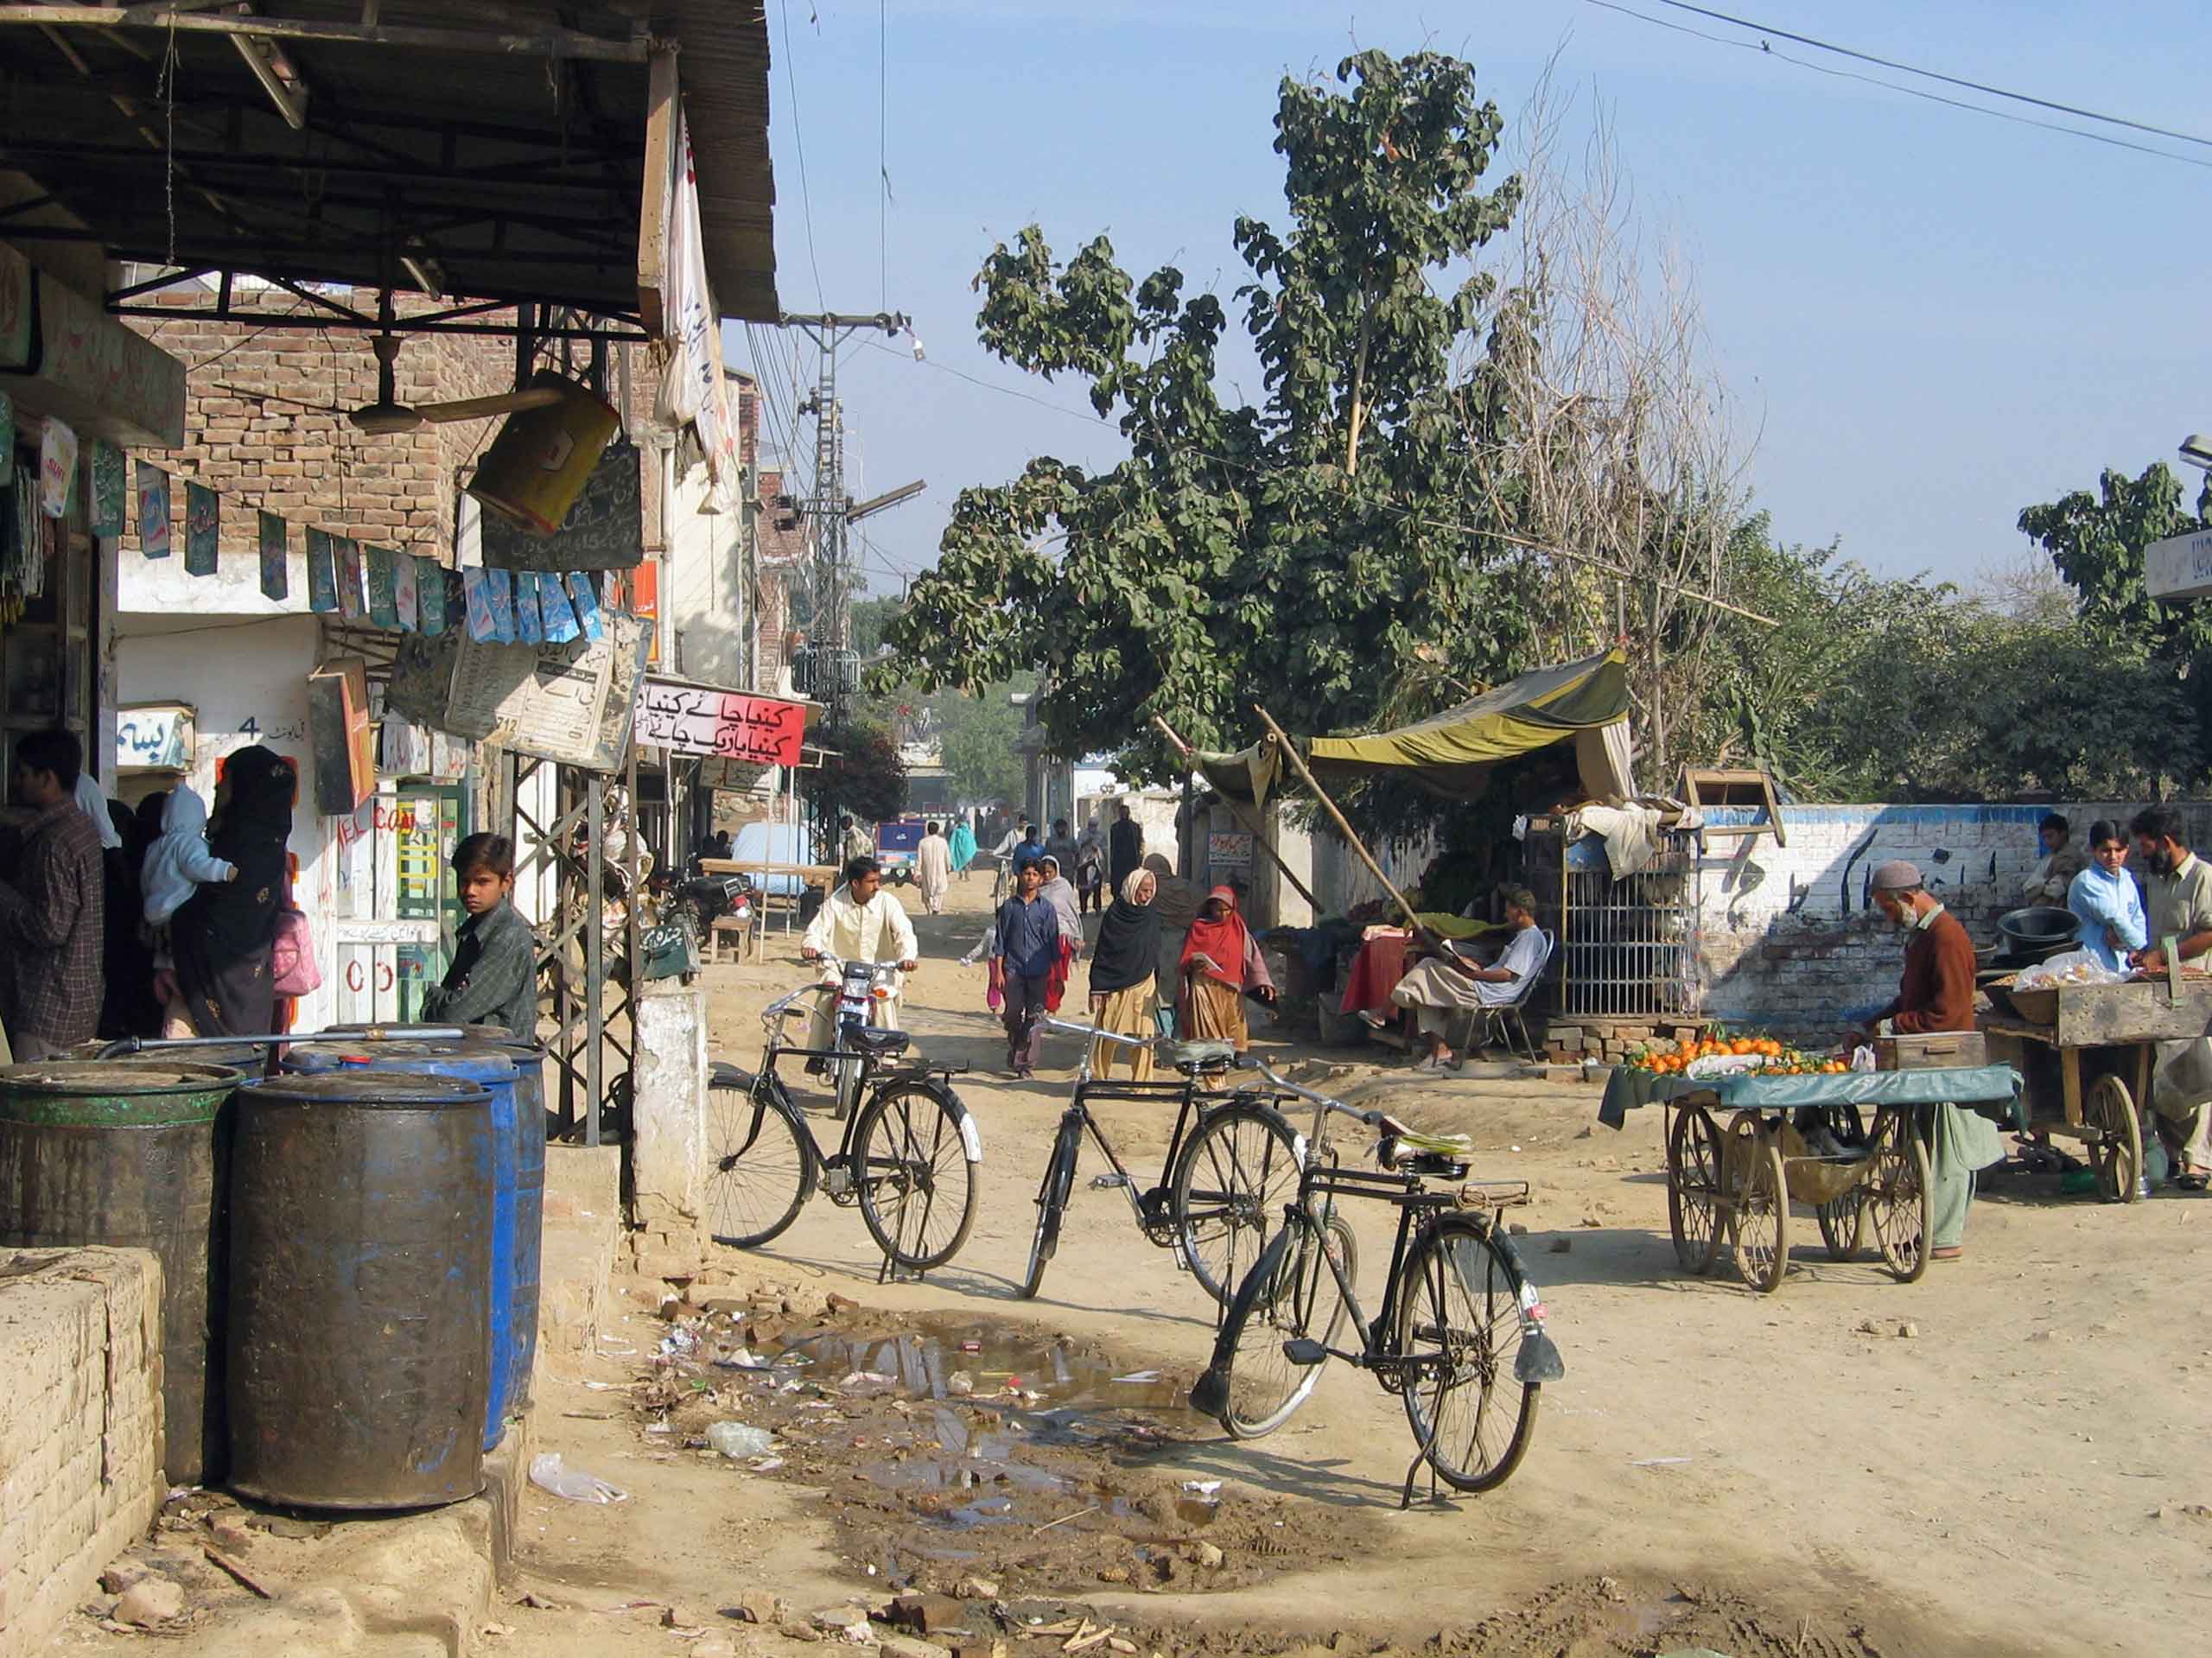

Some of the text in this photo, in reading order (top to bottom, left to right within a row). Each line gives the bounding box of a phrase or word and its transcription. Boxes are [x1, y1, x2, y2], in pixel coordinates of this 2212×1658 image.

[646, 684, 690, 721] کینیا
[685, 691, 744, 731] چائے
[746, 699, 794, 733] کینیا
[647, 715, 691, 751] چائے
[694, 726, 747, 757] باریک
[748, 730, 792, 761] کینیا
